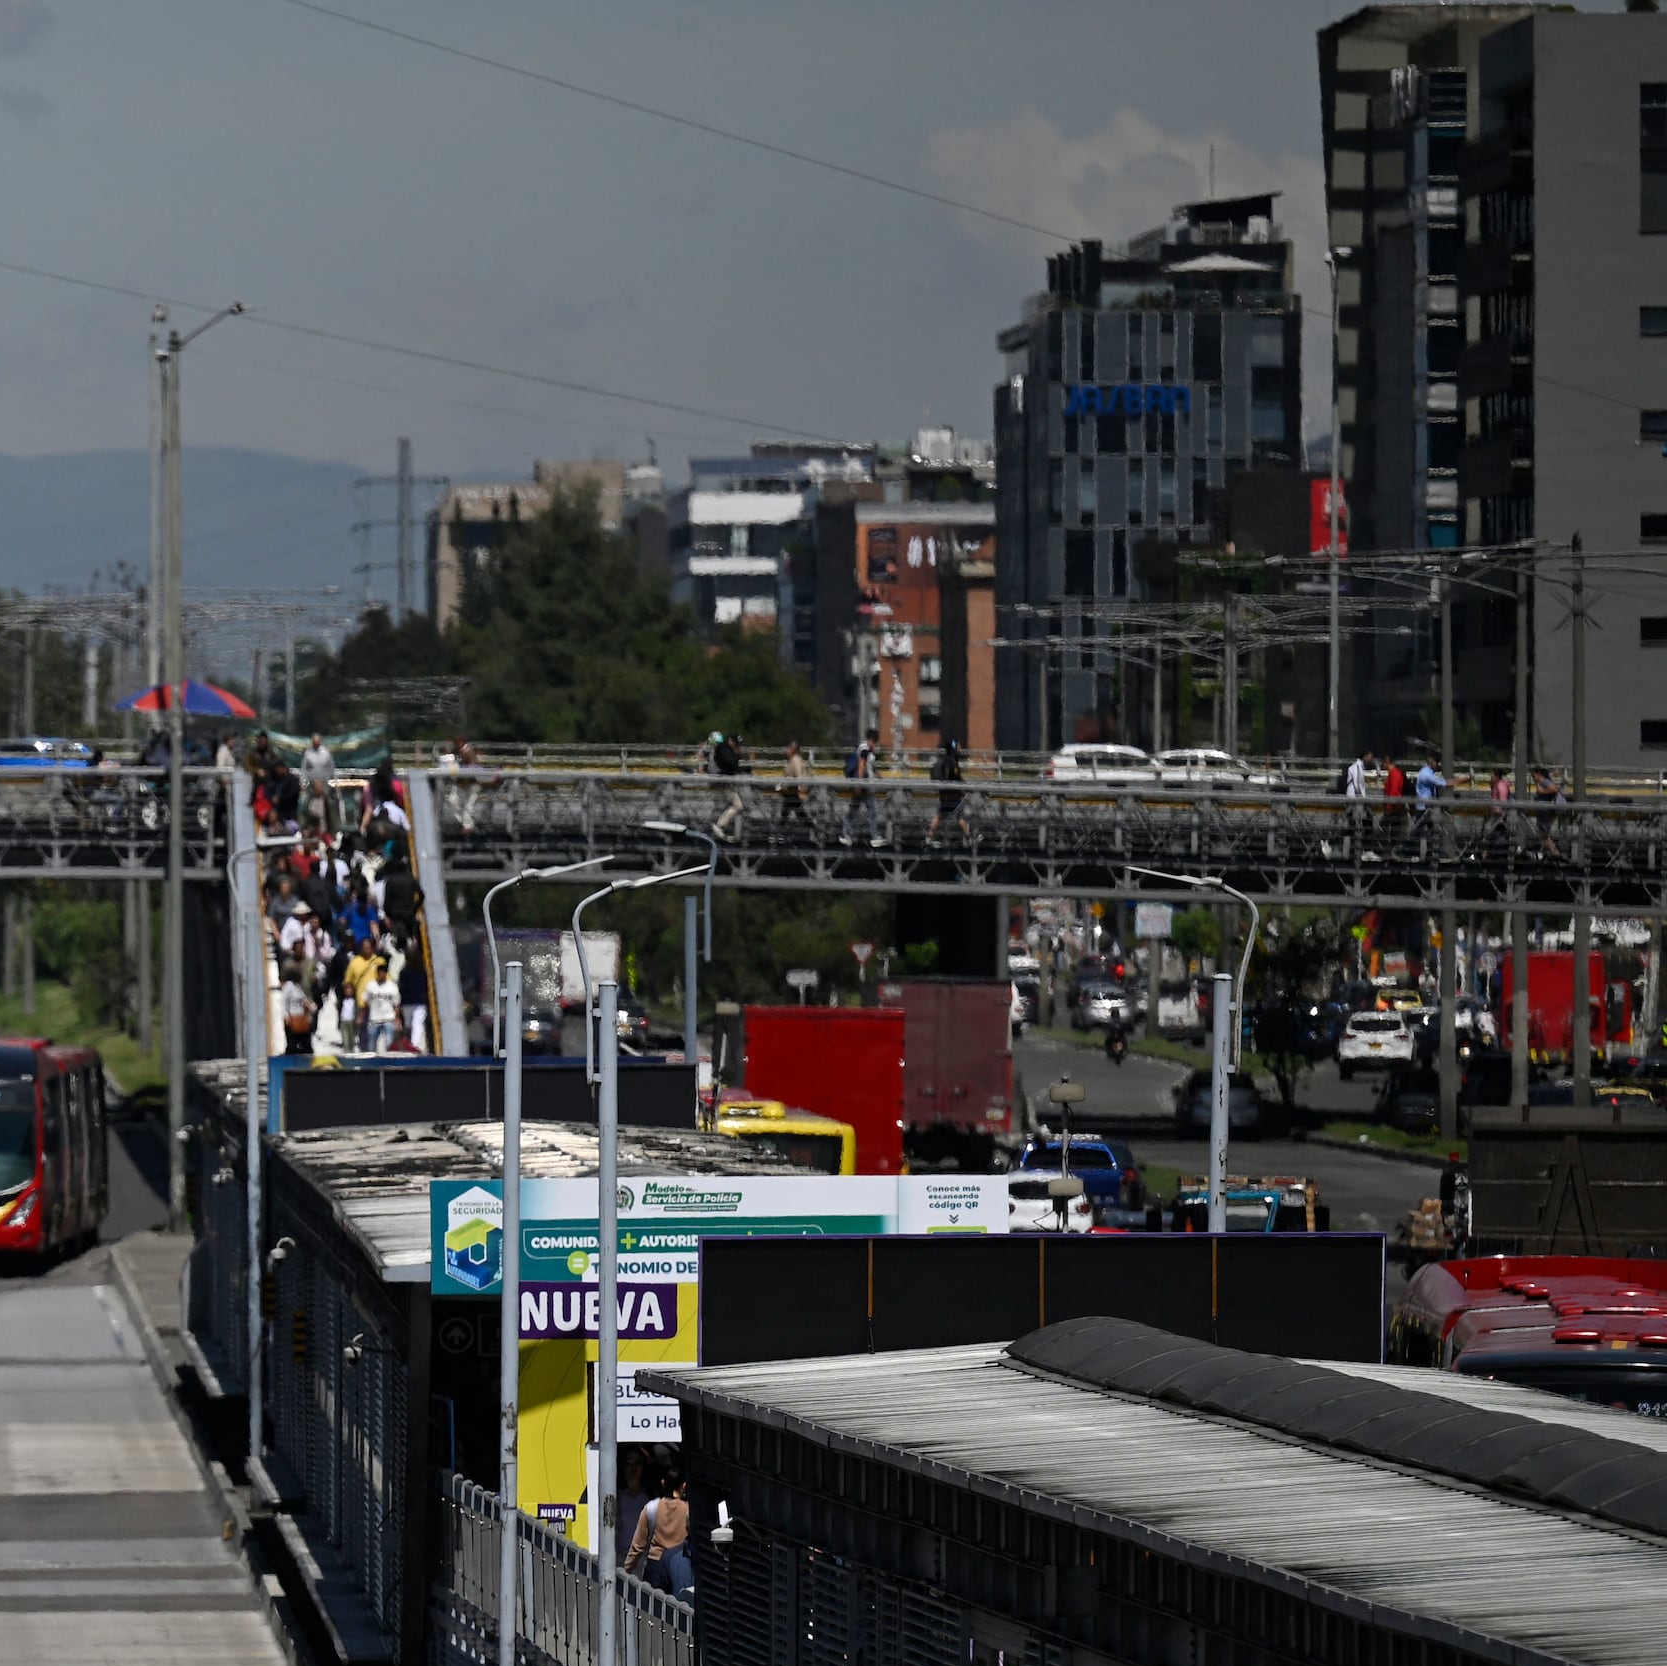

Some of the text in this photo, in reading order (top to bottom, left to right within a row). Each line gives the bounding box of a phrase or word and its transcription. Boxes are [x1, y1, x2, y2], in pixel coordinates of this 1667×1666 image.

[645, 1182, 685, 1193] Modelo
[645, 1194, 687, 1204] Servicio
[688, 1194, 702, 1203] de
[929, 1201, 979, 1210] código QR
[676, 1261, 697, 1273] DE
[521, 1291, 664, 1331] NUEVA
[631, 1415, 651, 1428] Lo
